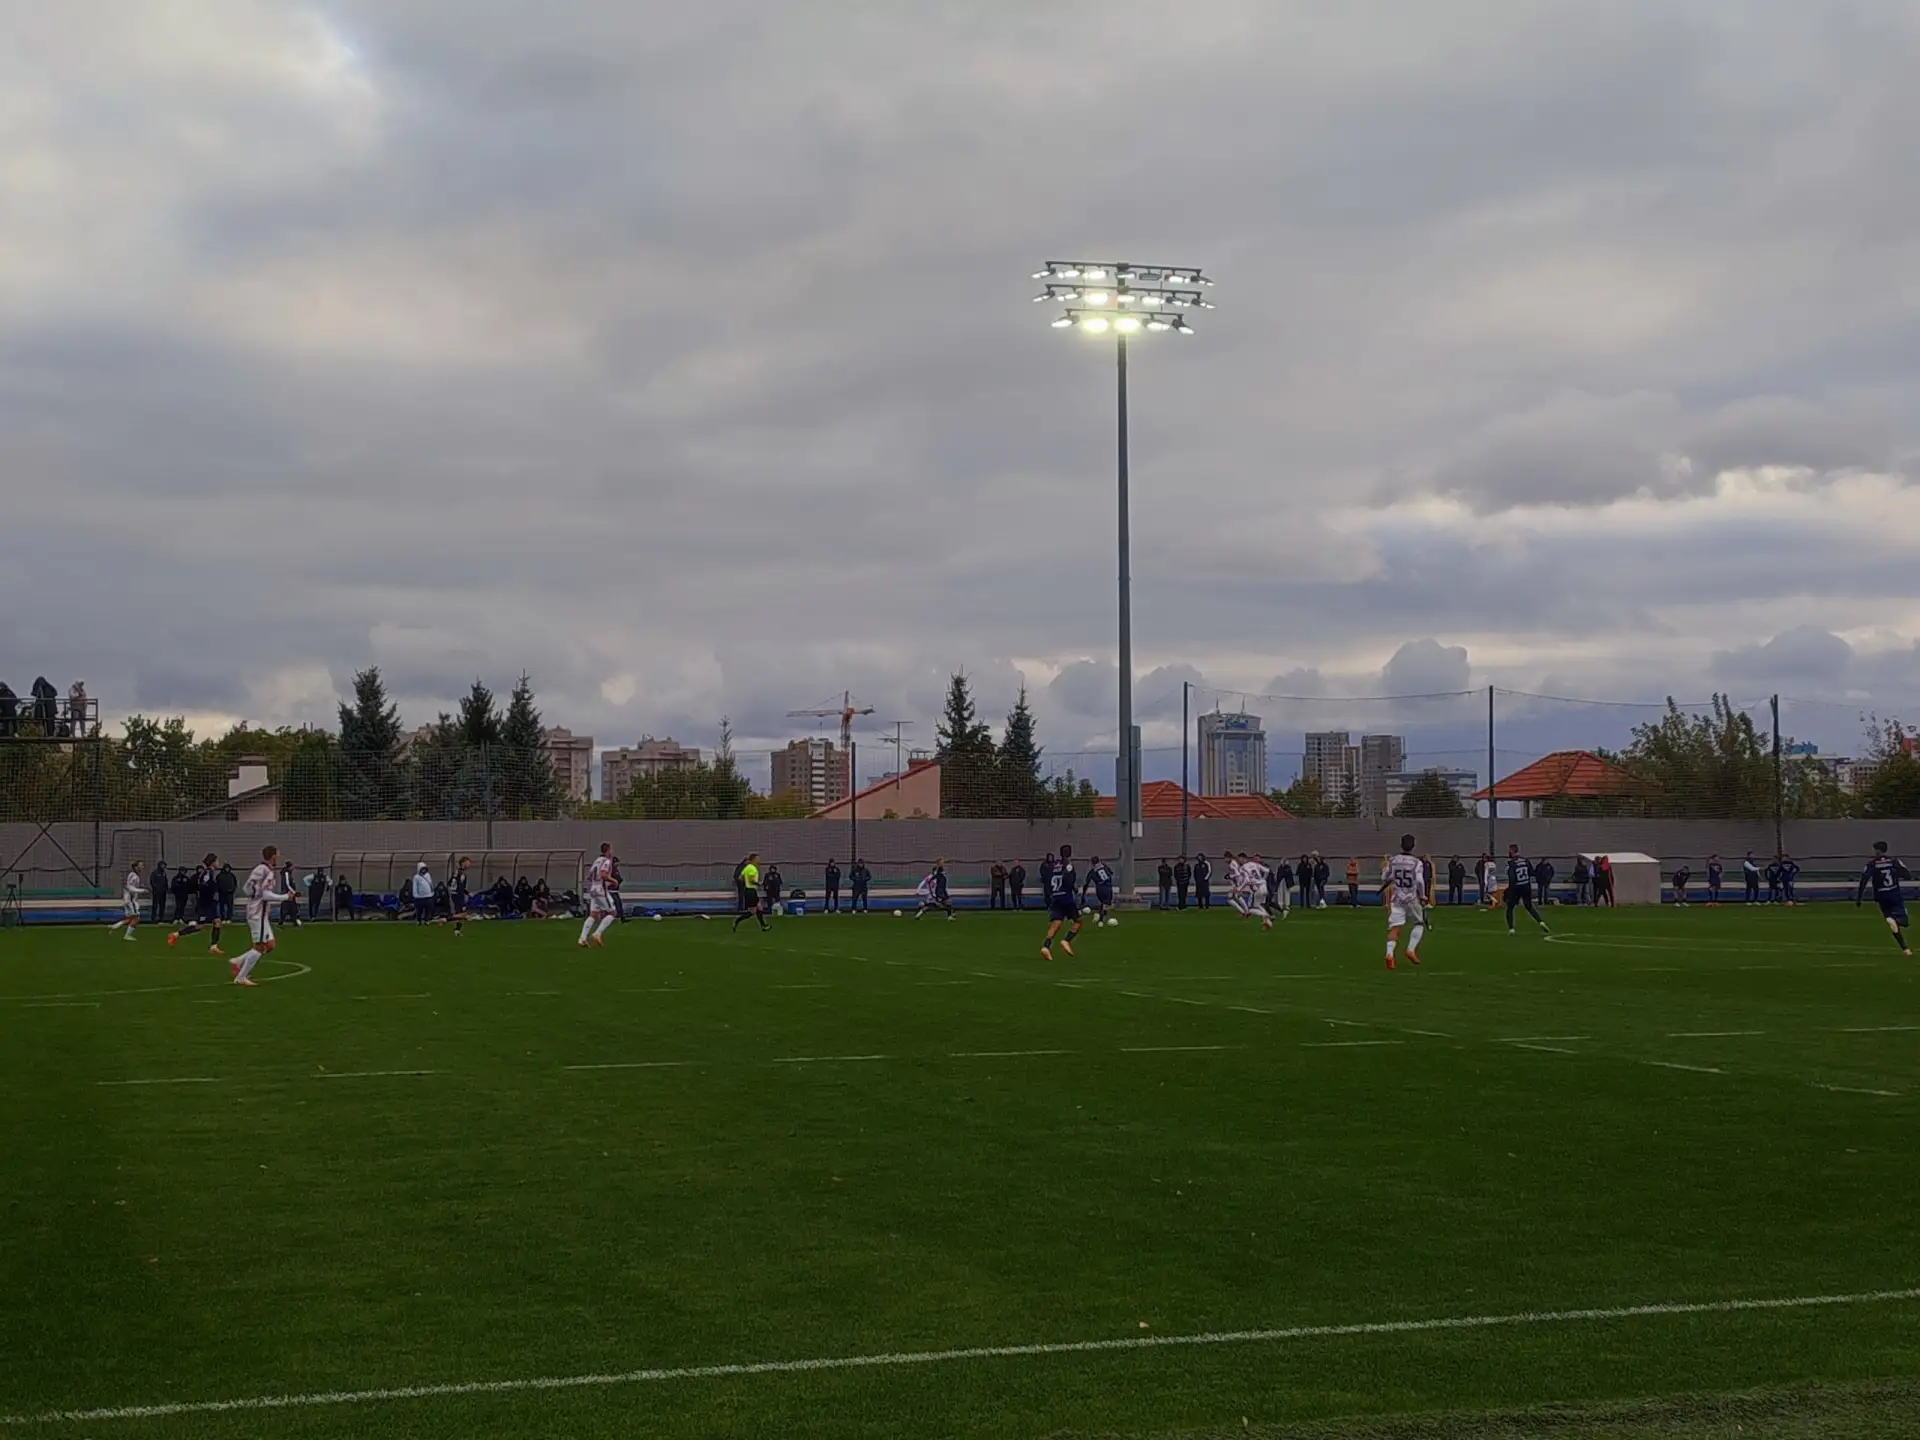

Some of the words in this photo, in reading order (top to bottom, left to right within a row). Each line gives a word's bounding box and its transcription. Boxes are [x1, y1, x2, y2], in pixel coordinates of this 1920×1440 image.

[1097, 869, 1109, 881] 8
[1394, 869, 1412, 888] 55
[1880, 868, 1893, 887] 3
